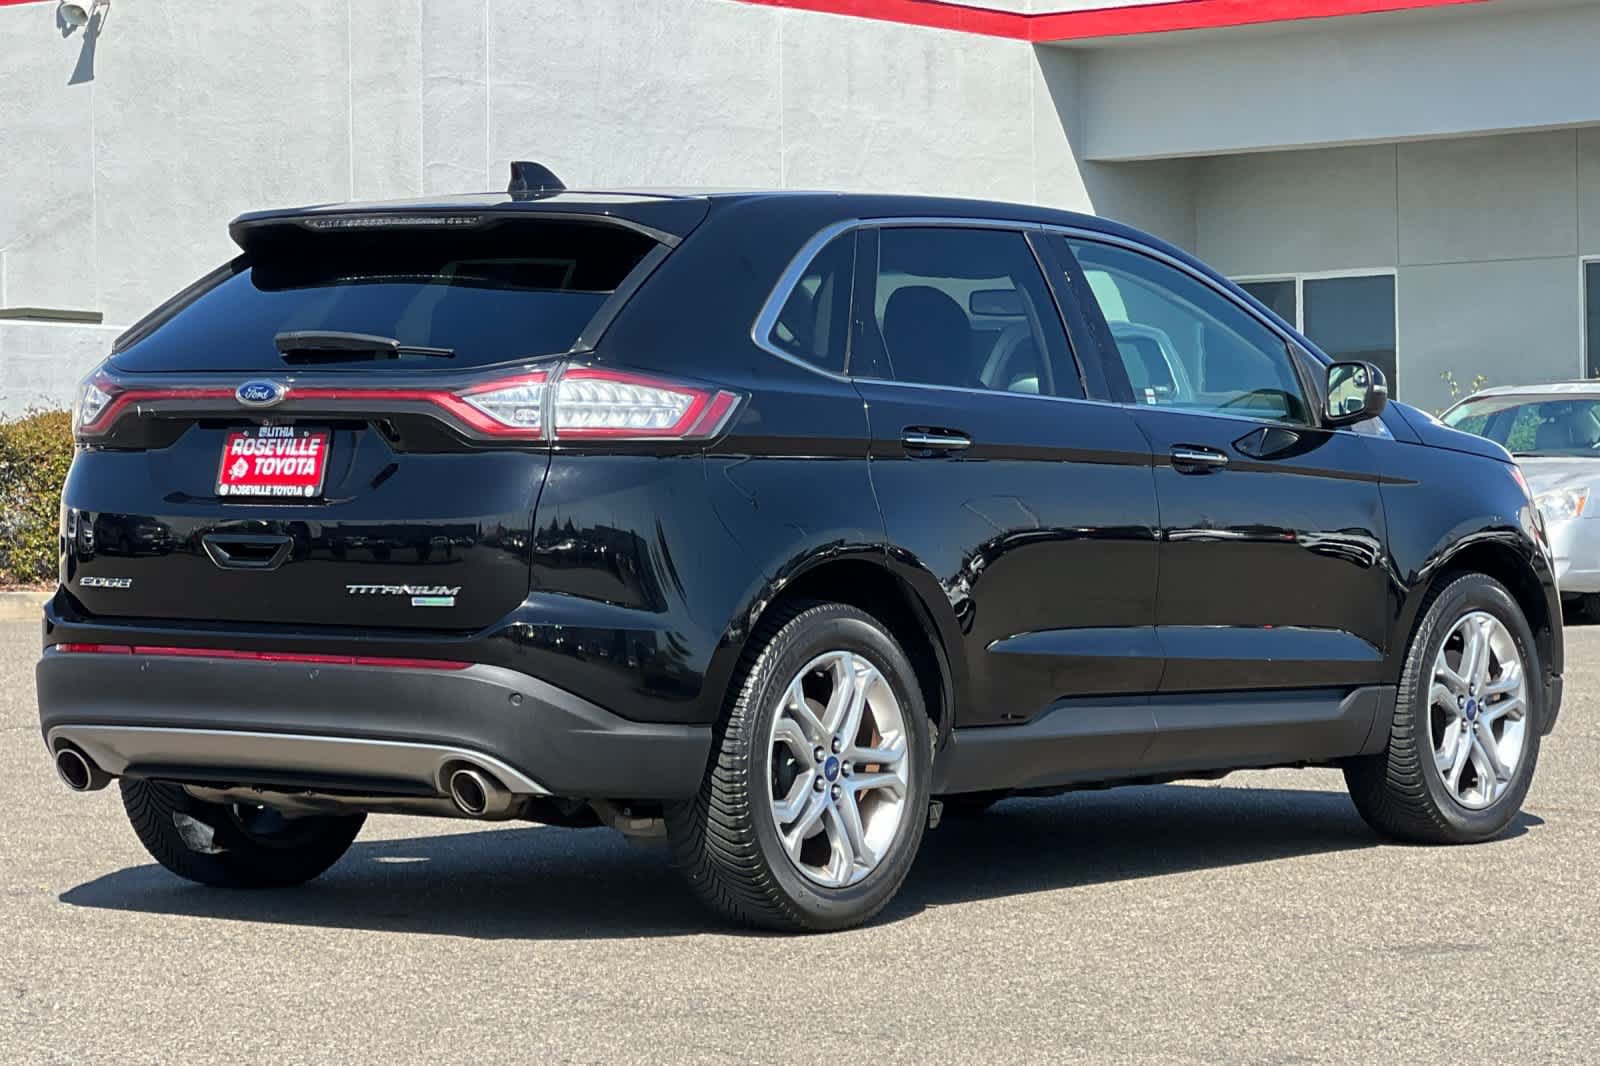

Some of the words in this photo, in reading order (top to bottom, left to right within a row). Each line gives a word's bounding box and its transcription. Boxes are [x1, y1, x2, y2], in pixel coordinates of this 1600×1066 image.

[245, 386, 270, 400] Ford
[267, 427, 294, 437] LITHIA
[231, 438, 320, 455] ROSEVILLE
[254, 458, 315, 475] TOYOTA
[79, 577, 132, 588] EDGE
[345, 585, 461, 596] TITANIUM
